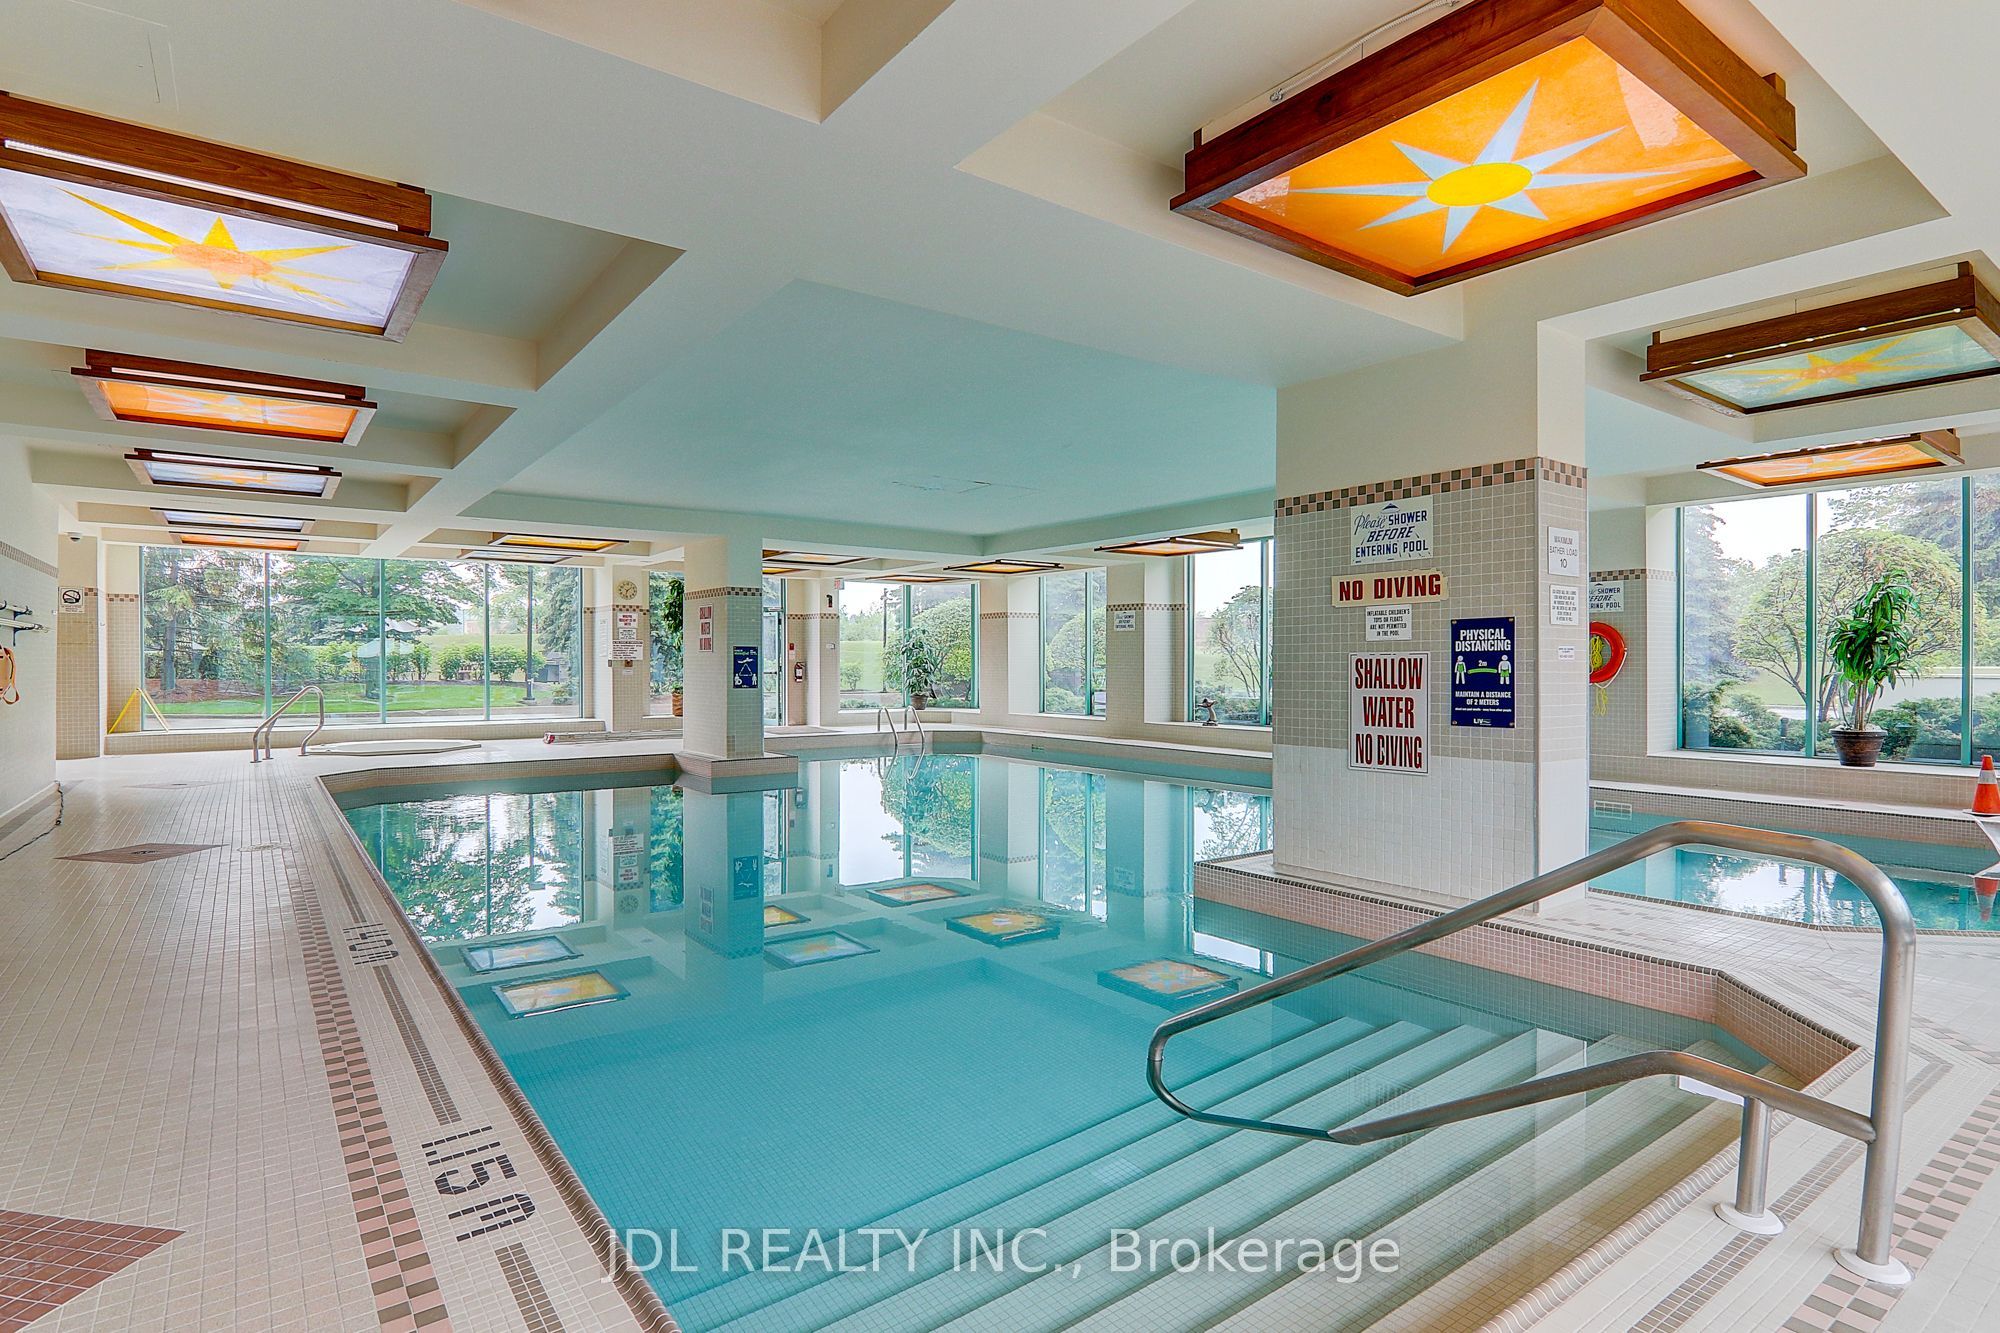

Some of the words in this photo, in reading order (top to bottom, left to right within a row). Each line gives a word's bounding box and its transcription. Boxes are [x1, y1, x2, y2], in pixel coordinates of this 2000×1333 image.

[1354, 512, 1386, 535] Please
[1388, 510, 1427, 525] SHOWER
[1366, 526, 1415, 543] BEFORE
[1355, 542, 1398, 558] ENTERING
[1403, 540, 1429, 553] POOL
[1560, 558, 1567, 568] 10
[1339, 580, 1363, 601] NO
[1374, 574, 1441, 599] DIVING
[1460, 628, 1506, 640] PHYSICAL
[1455, 640, 1511, 652] DISTANCING
[1355, 657, 1423, 689] SHALLOW
[1362, 696, 1415, 728] WATER
[1355, 733, 1373, 765] NO
[1377, 735, 1423, 769] DIVING
